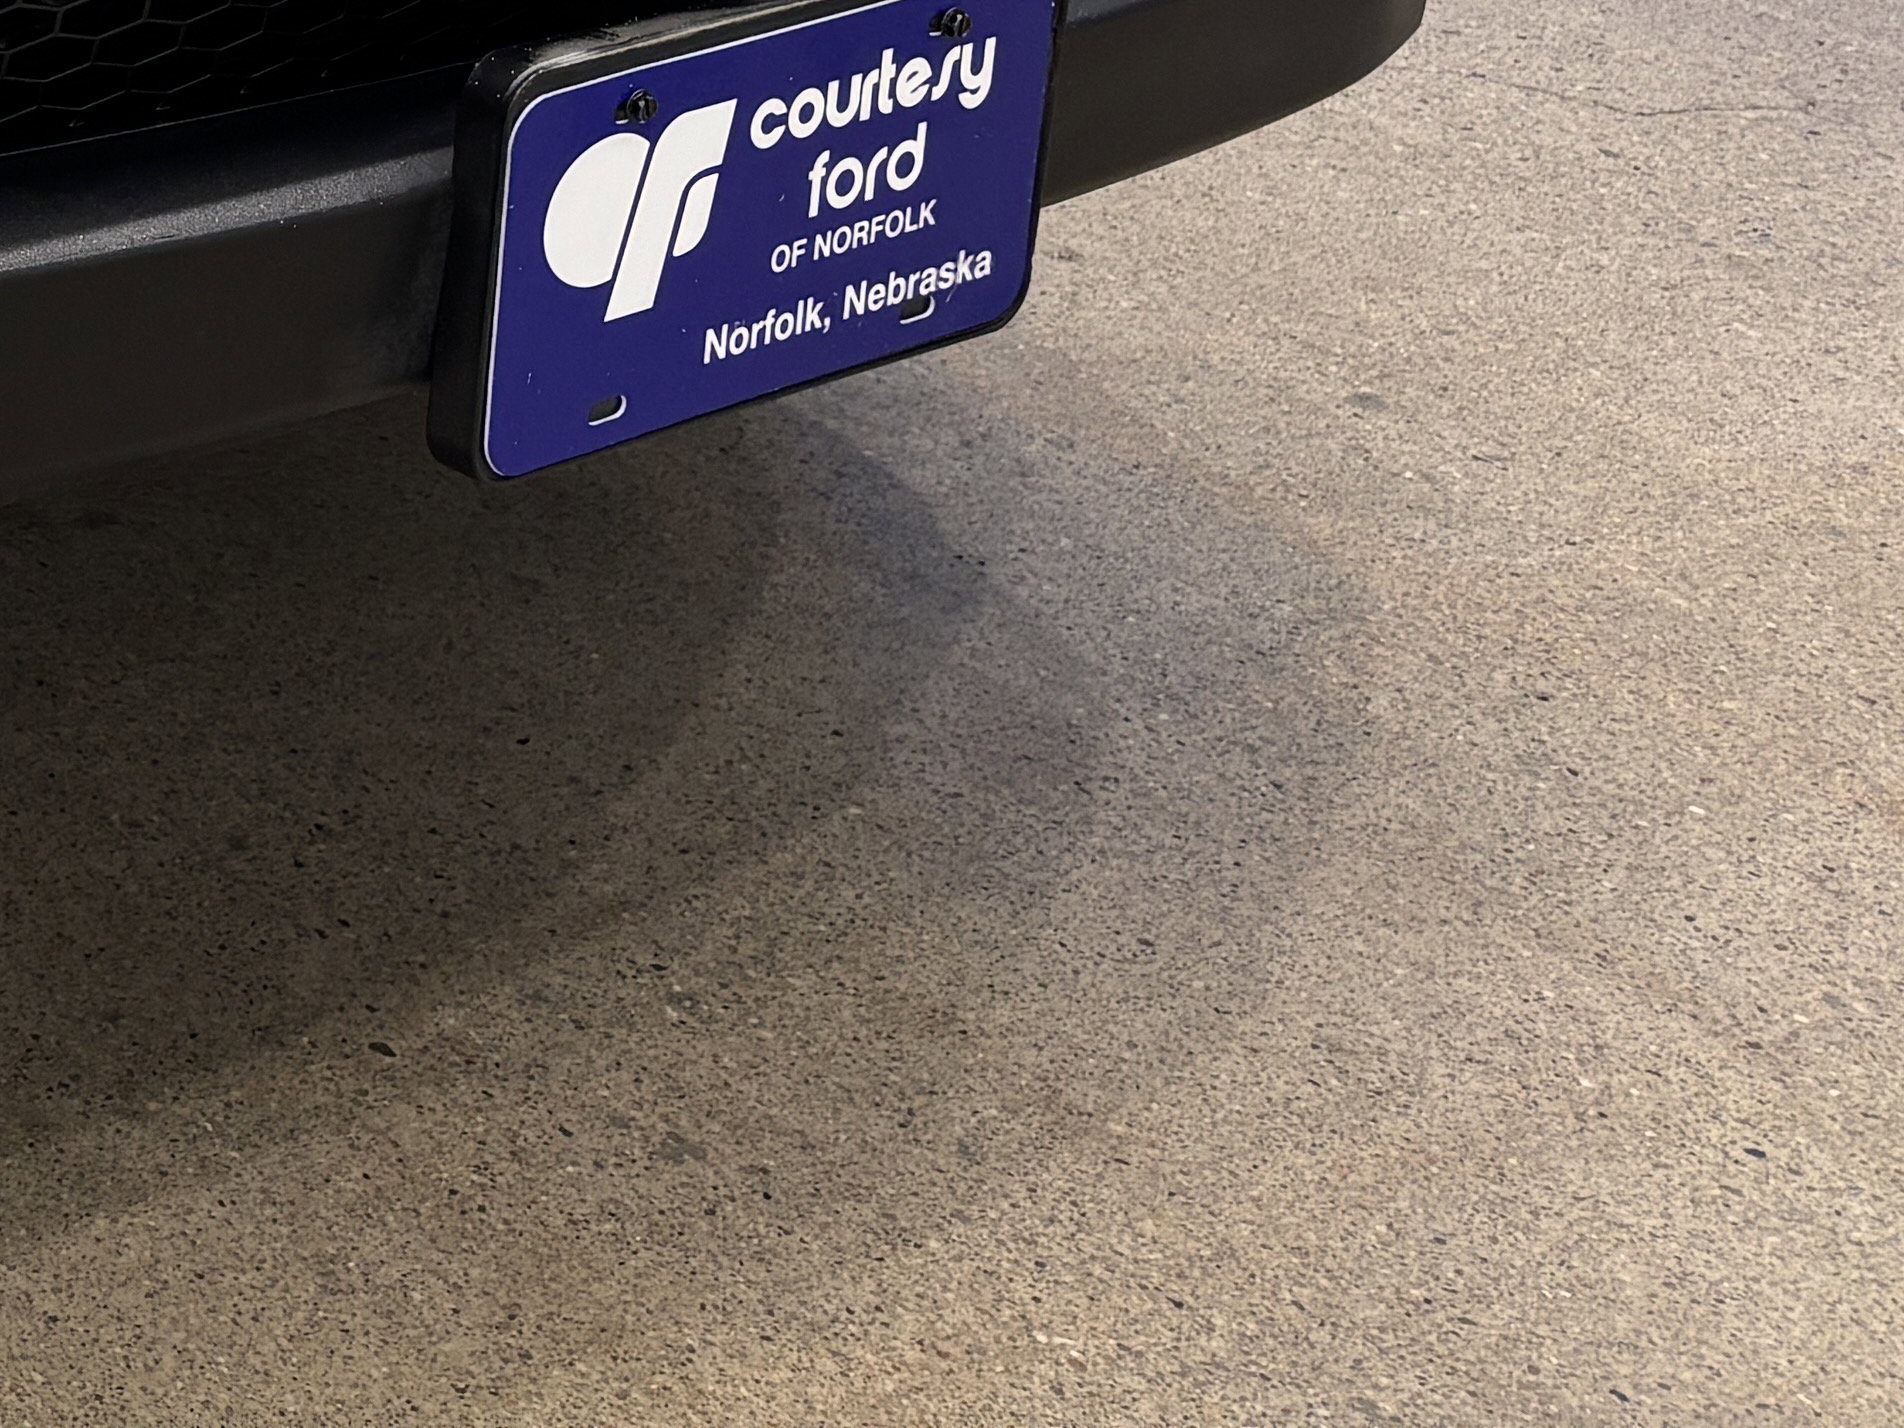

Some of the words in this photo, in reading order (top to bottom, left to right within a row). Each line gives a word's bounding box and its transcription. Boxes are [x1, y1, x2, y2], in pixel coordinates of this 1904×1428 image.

[750, 37, 996, 149] courtesy
[808, 122, 927, 217] ford
[771, 239, 807, 273] OF
[813, 199, 936, 261] NORFOLK
[704, 297, 832, 364] Norfolk,
[843, 250, 991, 319] Nebraska
